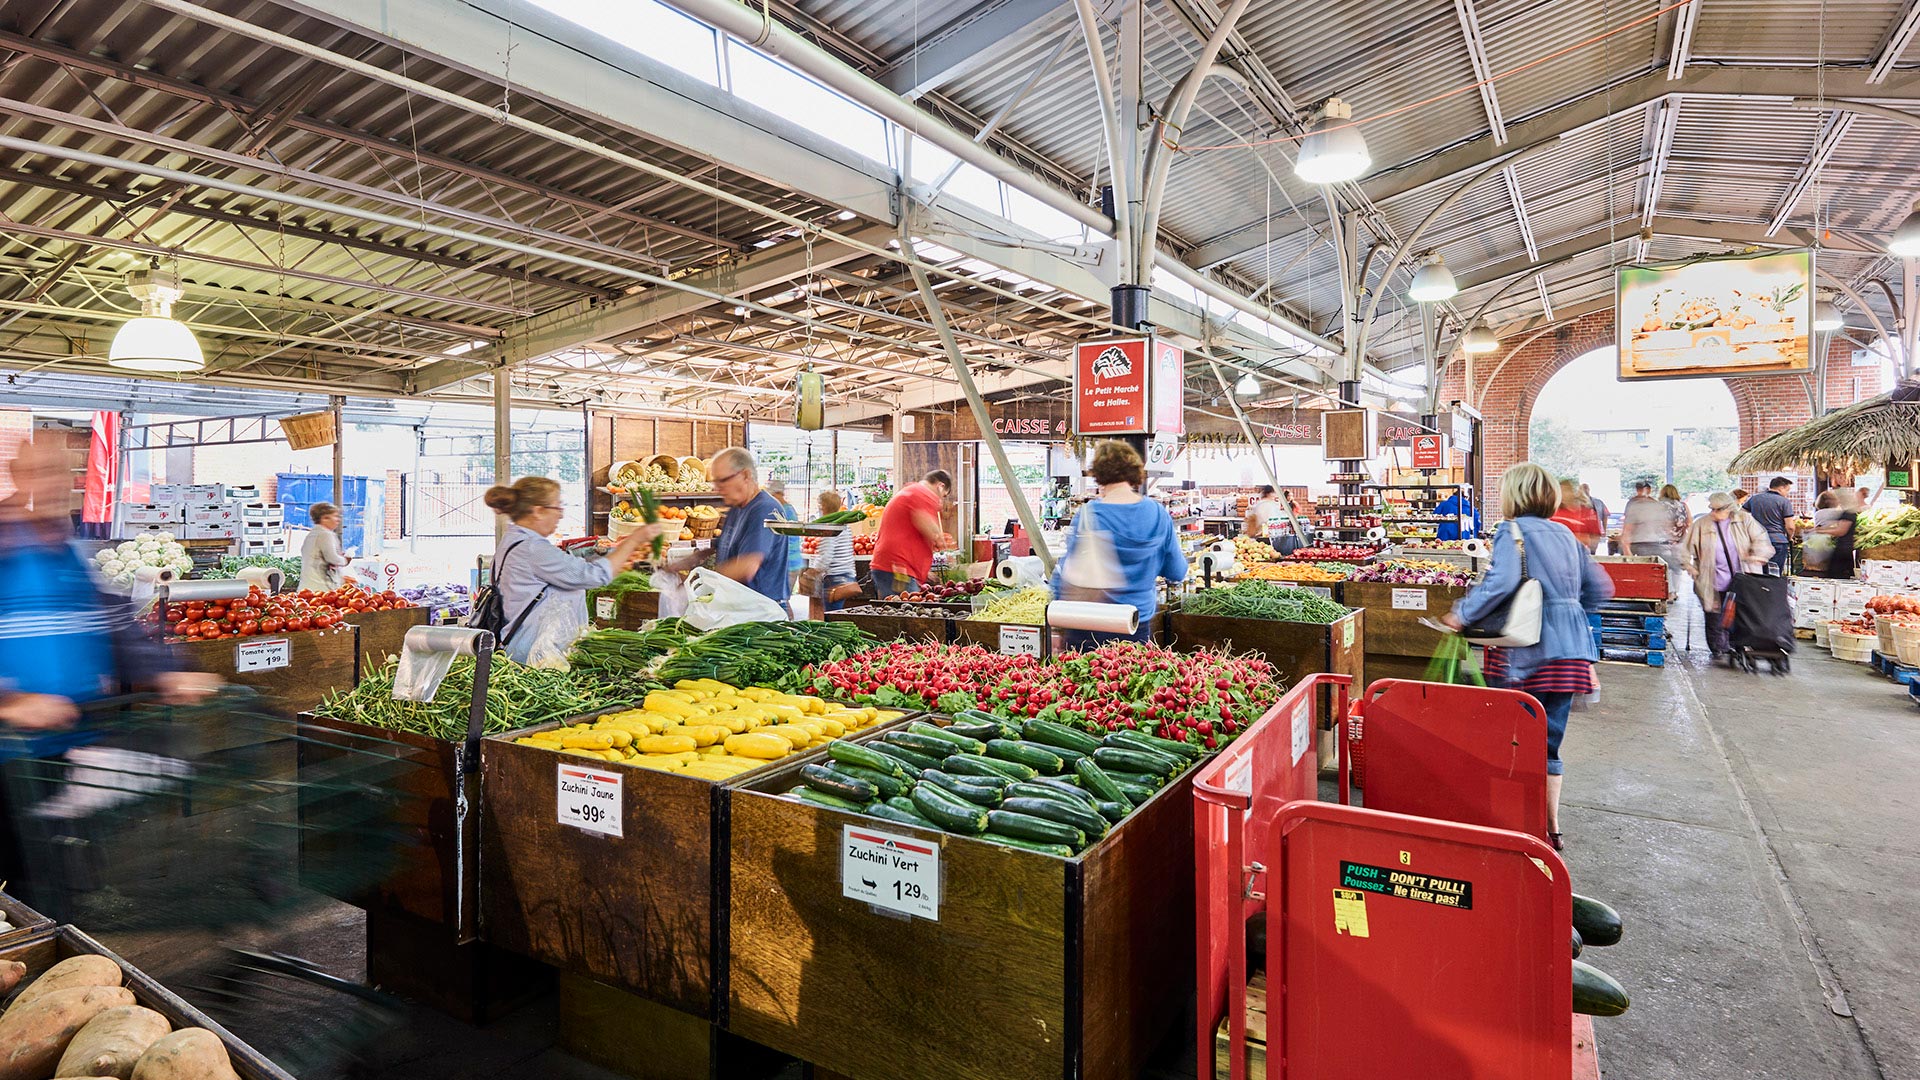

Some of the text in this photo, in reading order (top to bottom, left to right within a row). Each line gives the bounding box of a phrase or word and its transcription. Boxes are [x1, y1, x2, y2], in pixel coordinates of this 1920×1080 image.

[1095, 387, 1112, 395] Petit
[1114, 384, 1140, 394] Marché
[1093, 398, 1131, 407] des Halles.
[992, 418, 1067, 434] CAISSE 4
[1263, 424, 1311, 439] CAISSE
[266, 647, 282, 655] vigne
[265, 655, 282, 666] 199
[561, 780, 615, 801] Zuchini Jaune
[582, 804, 606, 823] 99¢
[849, 845, 888, 866] Zuchini
[892, 856, 919, 873] Vert
[1402, 852, 1409, 864] 3
[1346, 864, 1379, 879] PUSH
[1390, 871, 1428, 887] DON'T
[1429, 879, 1466, 896] PULL!
[892, 879, 921, 901] 129
[1344, 875, 1385, 892] Poussez
[1394, 884, 1408, 897] Ne
[1409, 887, 1434, 900] tirez
[1436, 892, 1461, 906] pas!
